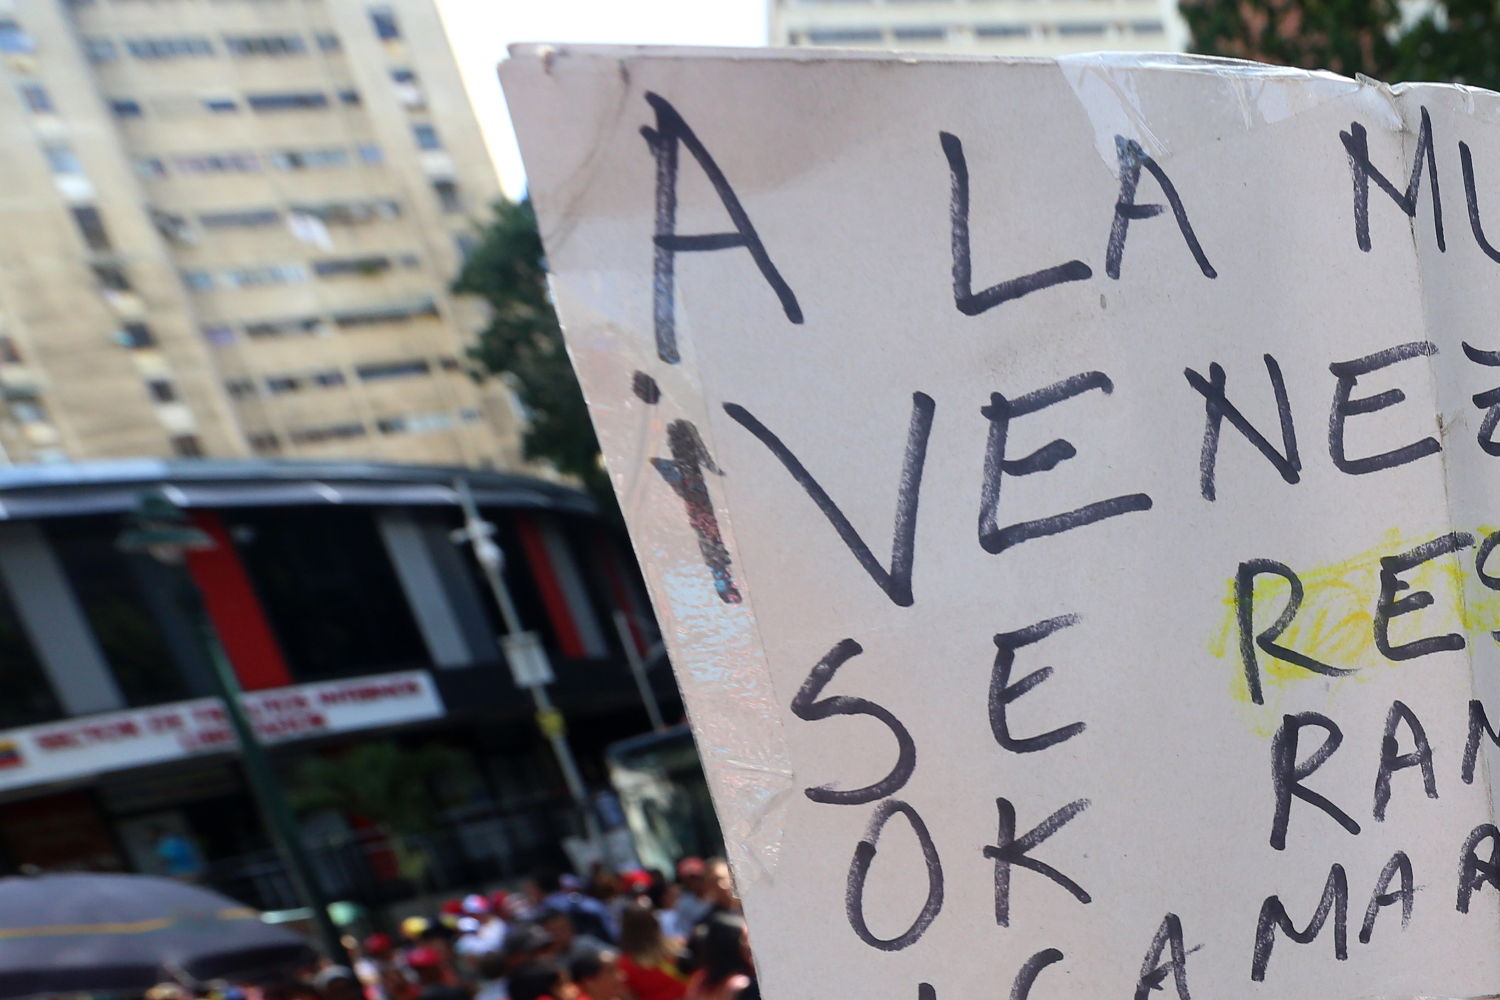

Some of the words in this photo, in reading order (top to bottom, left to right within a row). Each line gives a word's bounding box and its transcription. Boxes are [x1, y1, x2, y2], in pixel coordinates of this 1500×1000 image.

[640, 90, 804, 364] A
[940, 130, 1217, 316] LA
[792, 611, 1087, 804] SE
[845, 796, 1092, 951] OK
